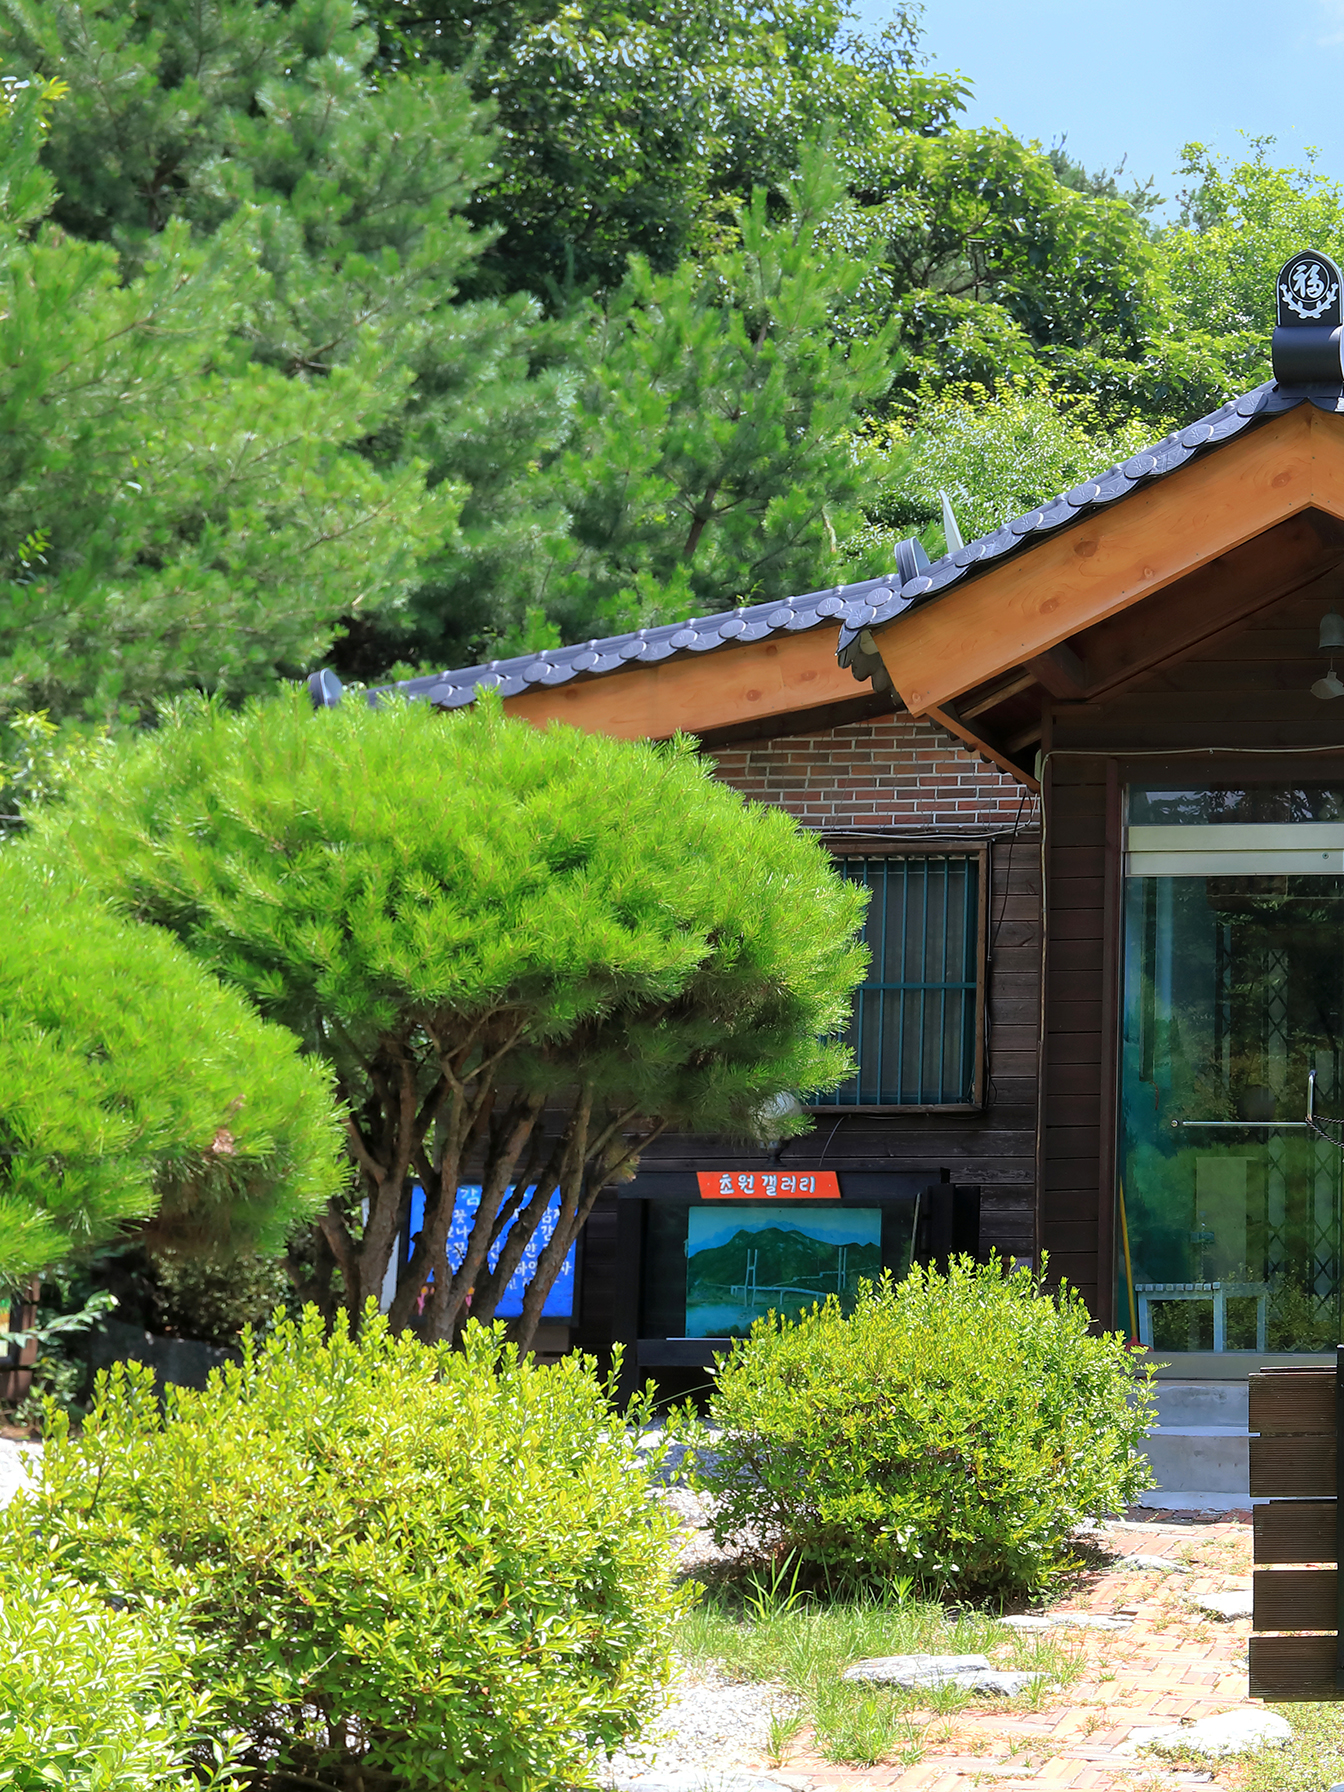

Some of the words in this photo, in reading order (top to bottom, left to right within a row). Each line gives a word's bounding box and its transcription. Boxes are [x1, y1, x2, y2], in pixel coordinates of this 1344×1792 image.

[1293, 264, 1325, 298] 福
[719, 1173, 755, 1195] 초원
[761, 1174, 816, 1197] 갤러리
